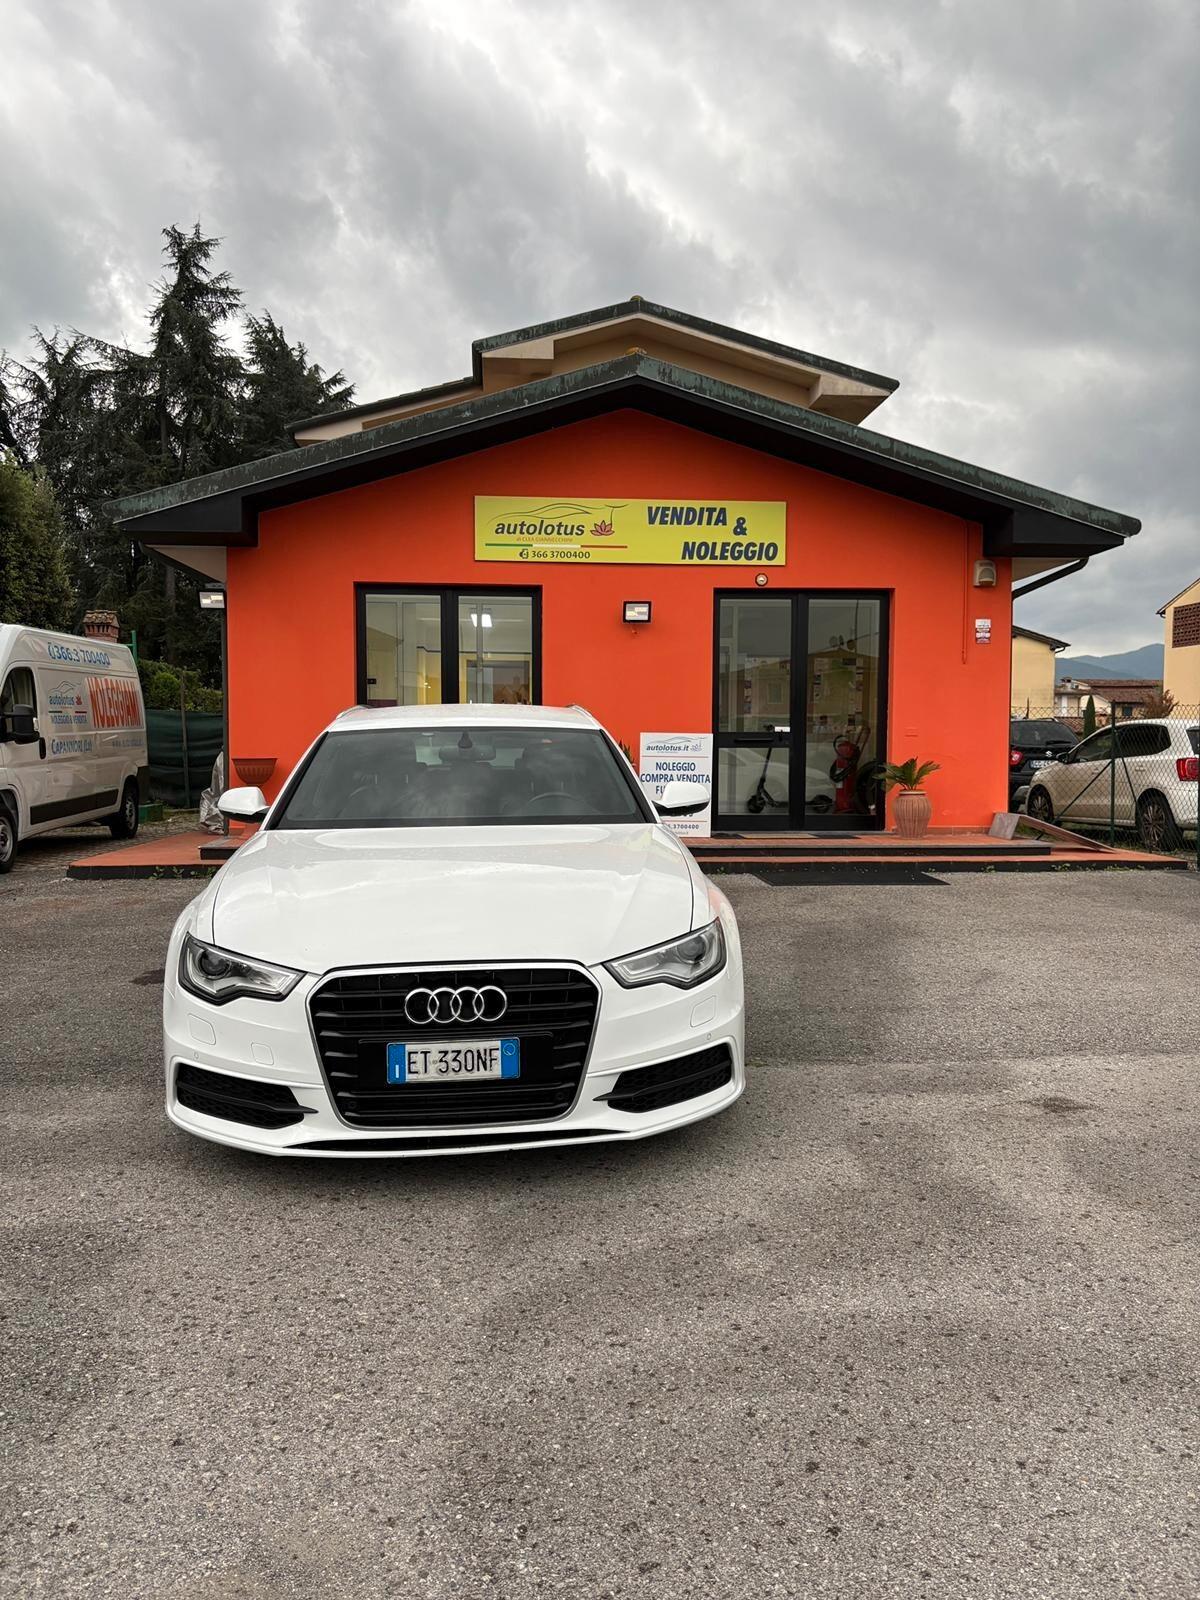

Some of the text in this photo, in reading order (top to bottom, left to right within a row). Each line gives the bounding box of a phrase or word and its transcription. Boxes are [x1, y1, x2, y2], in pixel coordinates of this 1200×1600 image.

[647, 506, 728, 526] VENDITA
[495, 519, 585, 536] autolotus
[733, 516, 748, 536] &
[532, 550, 591, 559] 366 3700400
[681, 541, 779, 561] NOLEGGIO
[656, 762, 696, 772] NOLEGGIO
[640, 773, 711, 784] COMPRA VENDITA
[408, 1051, 431, 1074] ET
[438, 1048, 500, 1073] 330NF
